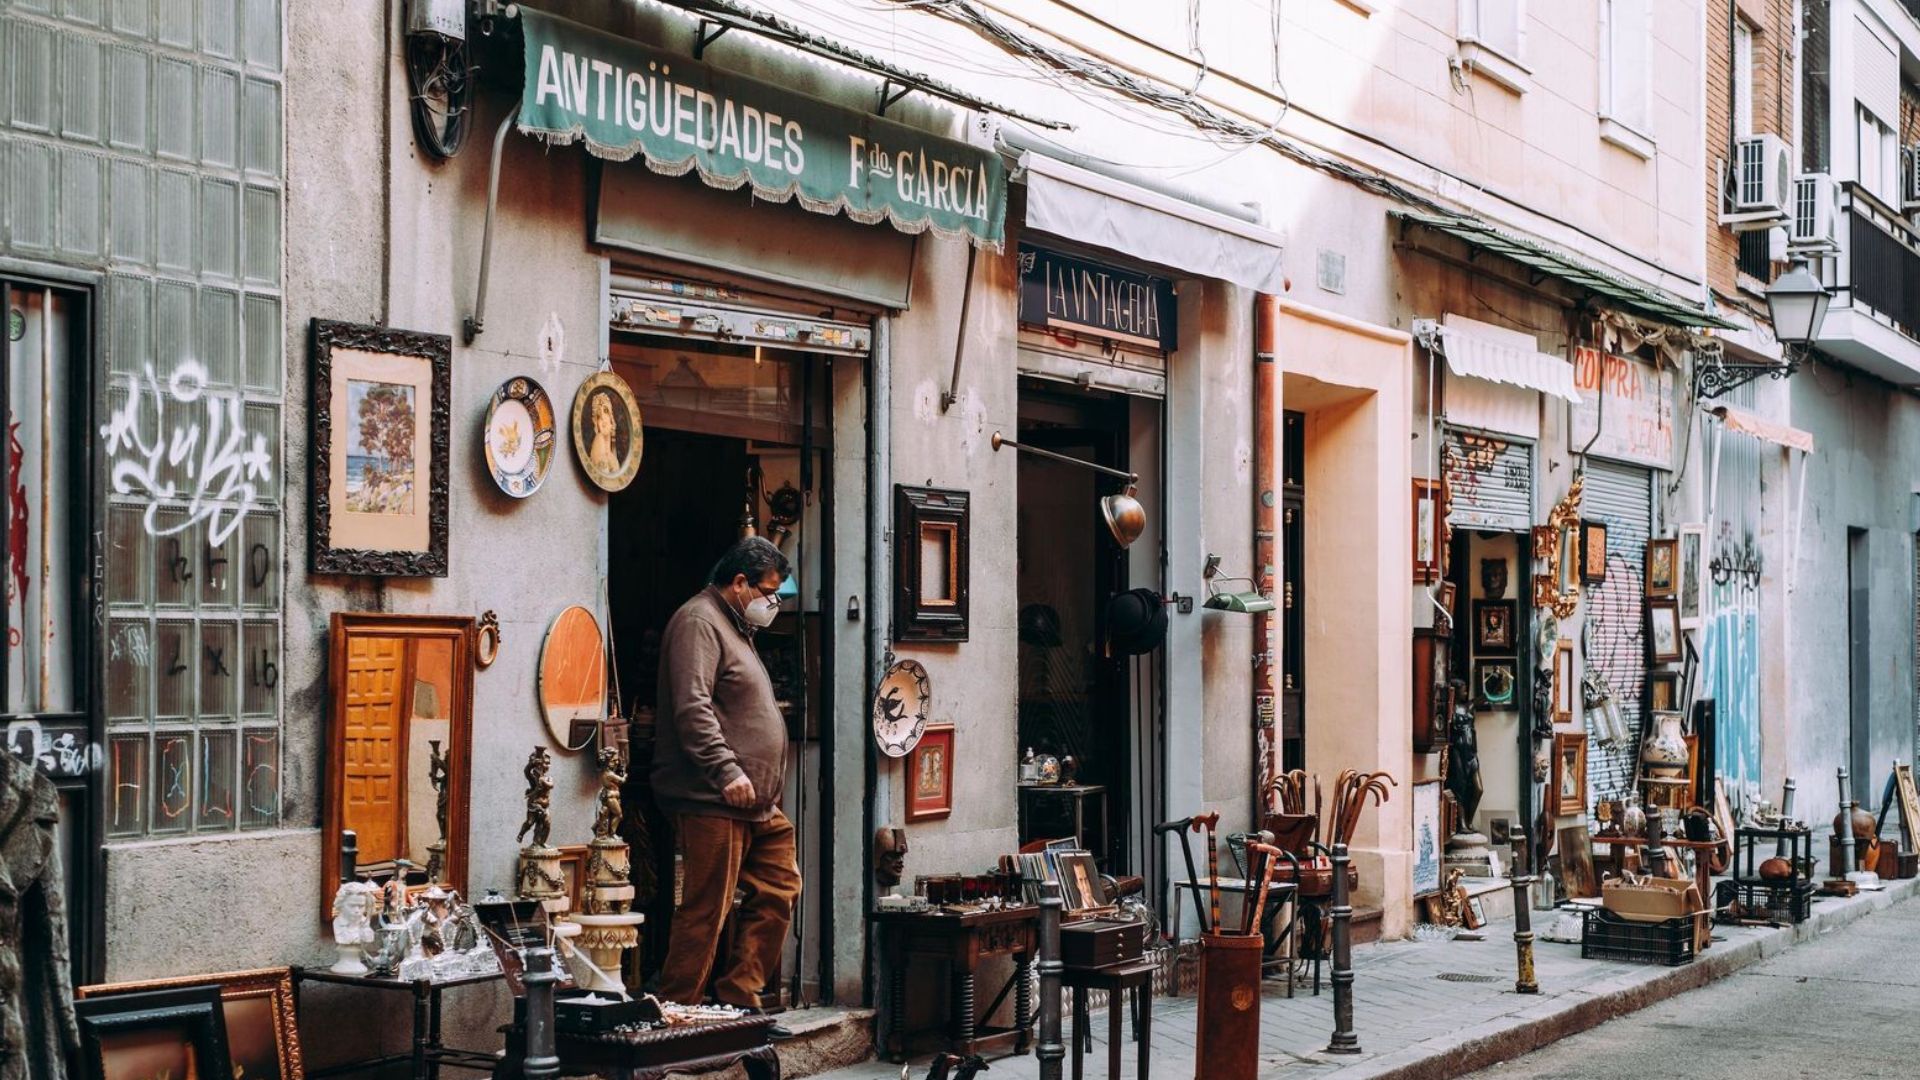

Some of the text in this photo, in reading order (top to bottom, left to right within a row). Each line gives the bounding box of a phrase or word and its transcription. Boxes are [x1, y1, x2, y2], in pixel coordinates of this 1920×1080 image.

[536, 44, 805, 175] ANTIGÜEDADES
[896, 147, 988, 221] GARCIA
[1046, 260, 1068, 318] LA
